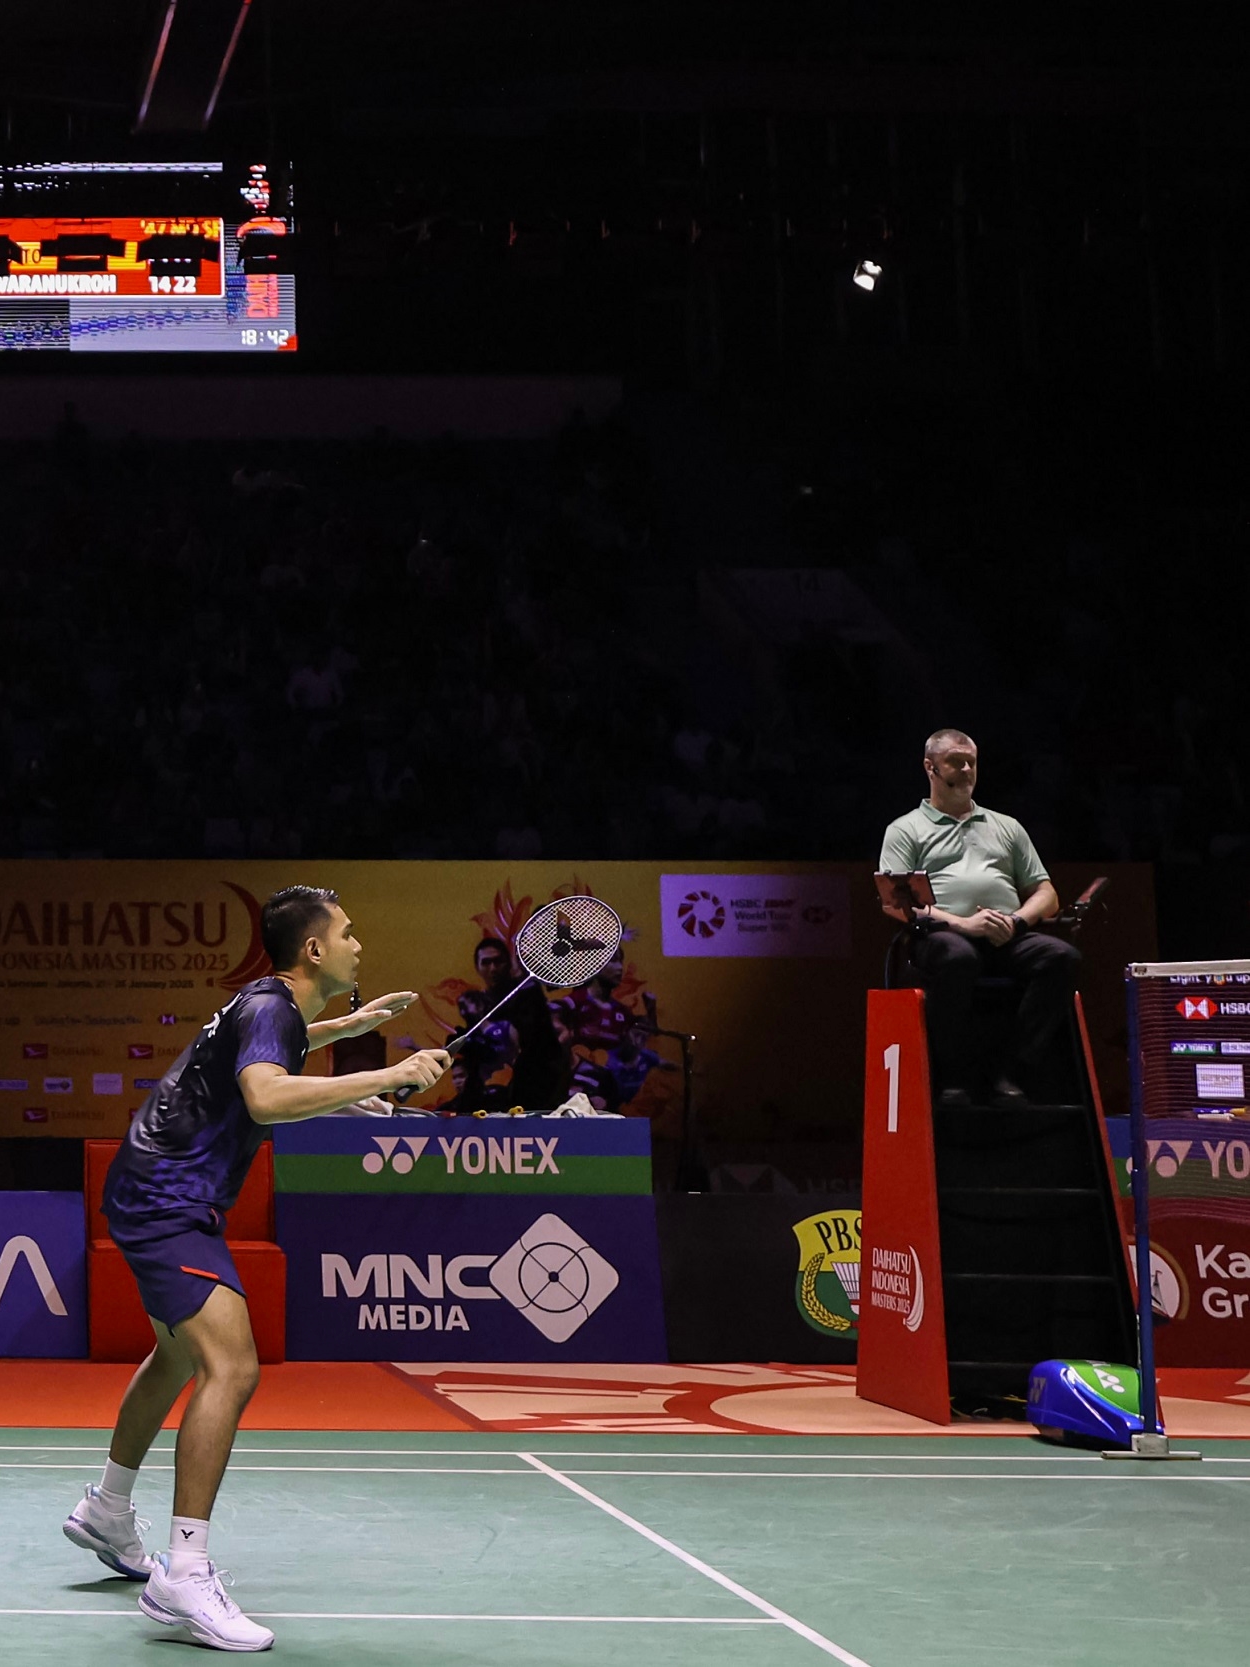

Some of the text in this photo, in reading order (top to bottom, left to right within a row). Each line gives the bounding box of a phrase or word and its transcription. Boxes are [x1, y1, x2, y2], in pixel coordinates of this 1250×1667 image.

[149, 275, 171, 293] 14
[174, 275, 196, 293] 22
[241, 329, 289, 346] 18:42
[734, 910, 767, 921] World
[82, 952, 176, 971] MASTERS
[182, 952, 229, 971] 2025
[883, 1042, 901, 1134] 1
[438, 1136, 560, 1176] YONEX
[872, 1247, 912, 1275] DAIHATSU
[321, 1253, 501, 1300] MNC
[871, 1270, 911, 1297] INDONESIA
[871, 1291, 897, 1311] MASTERS
[356, 1304, 471, 1332] MEDIA
